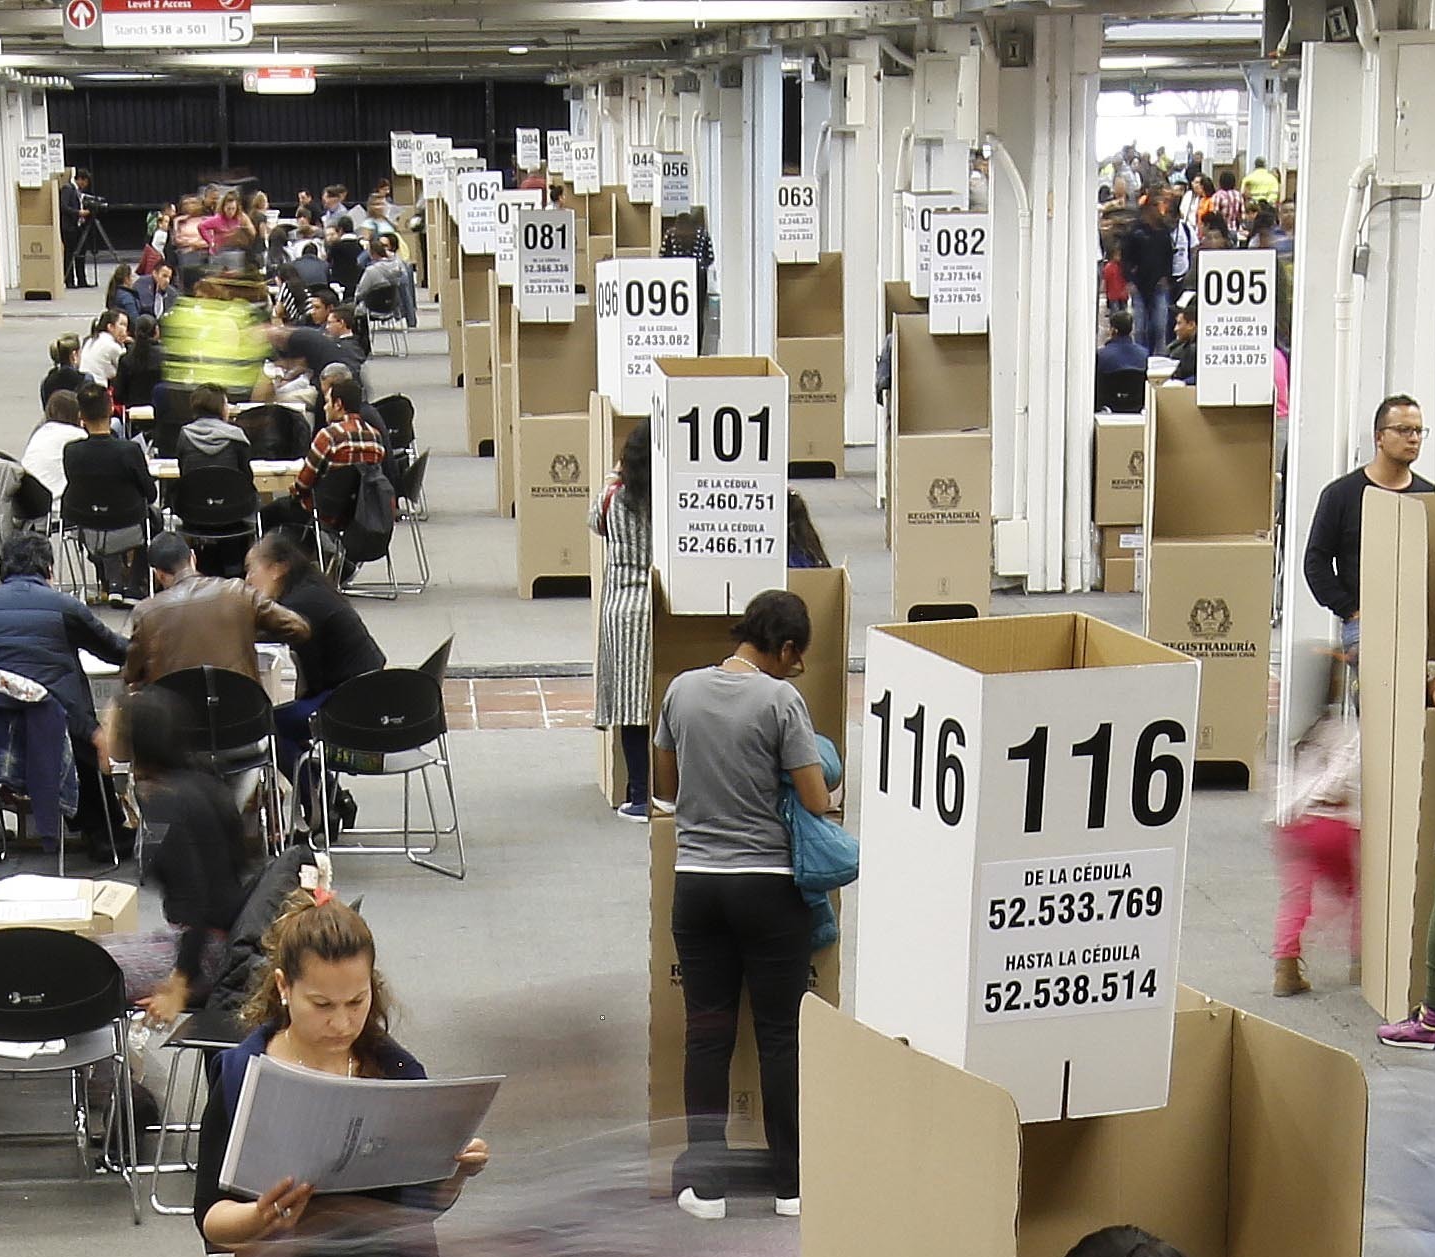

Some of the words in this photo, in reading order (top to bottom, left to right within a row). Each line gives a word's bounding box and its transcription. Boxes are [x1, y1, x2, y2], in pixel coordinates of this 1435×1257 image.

[151, 24, 173, 35] 538
[187, 24, 207, 35] 501
[229, 15, 245, 42] 5
[20, 146, 38, 158] 022
[575, 147, 596, 160] 037
[663, 162, 688, 177] 056
[778, 186, 813, 207] 063
[524, 223, 567, 250] 081
[936, 228, 985, 256] 082
[598, 280, 618, 318] 096
[625, 280, 689, 316] 096
[1204, 269, 1267, 306] 095
[678, 405, 770, 462] 101
[697, 479, 708, 488] DE
[711, 479, 722, 488] LA
[724, 478, 758, 489] CÉDULA
[679, 492, 775, 510] 52.460.751
[689, 522, 716, 532] HASTA
[718, 523, 729, 533] LA
[731, 522, 765, 533] CÉDULA
[678, 536, 775, 554] 52.466.117
[870, 689, 966, 827] 116
[1007, 719, 1187, 833] 116
[1024, 870, 1044, 886] DE
[1049, 869, 1068, 884] LA
[1073, 862, 1132, 883] CÉDULA
[988, 885, 1163, 930] 52.533.769
[1005, 952, 1053, 971] HASTA
[1059, 951, 1076, 966] LA
[1082, 944, 1140, 964] CÉDULA
[985, 968, 1157, 1013] 52.538.514
